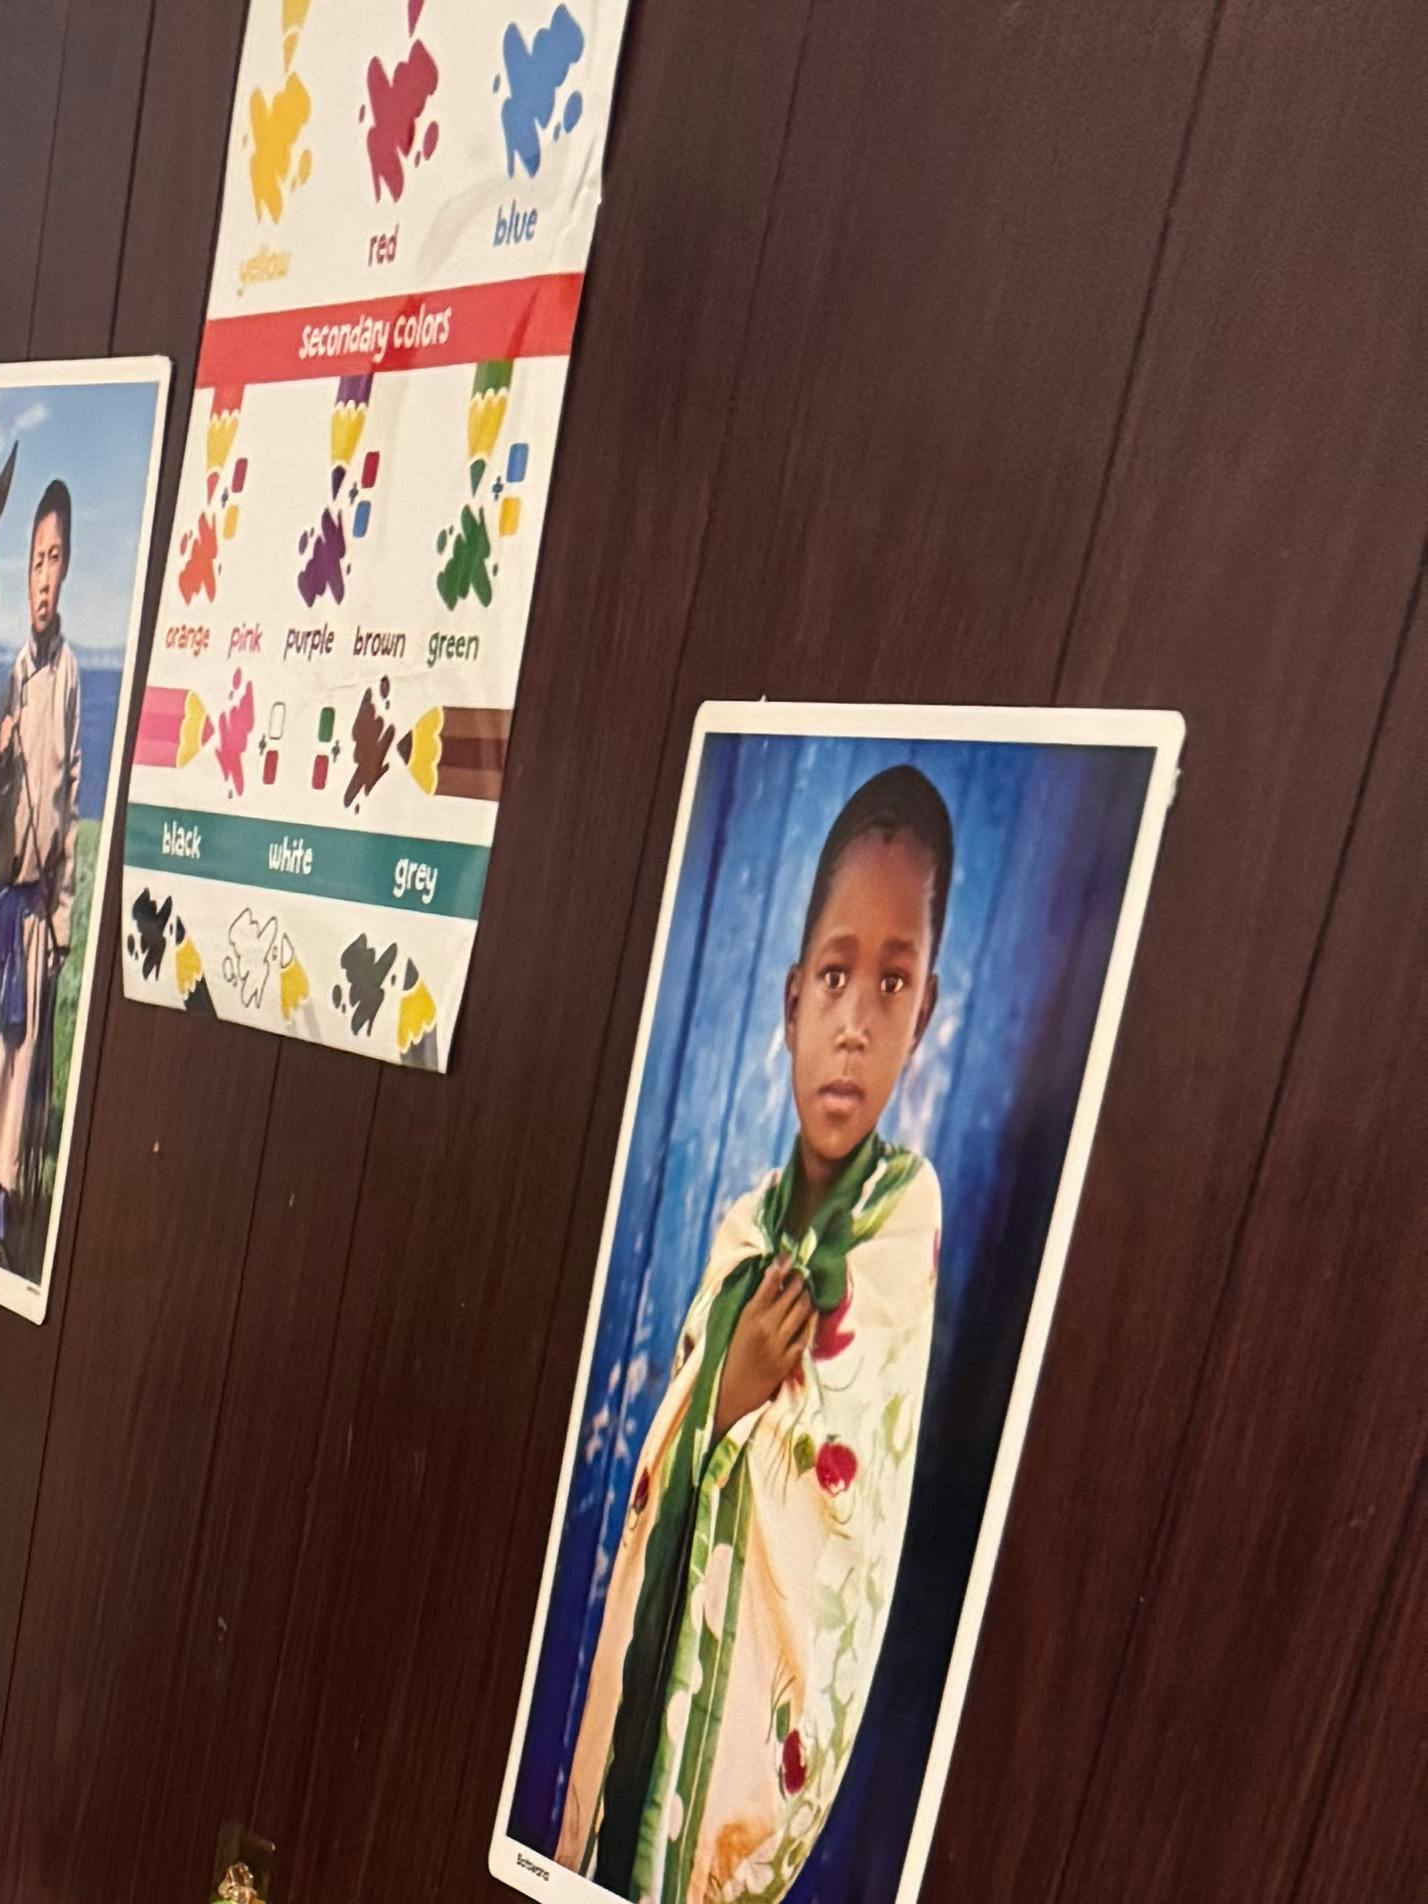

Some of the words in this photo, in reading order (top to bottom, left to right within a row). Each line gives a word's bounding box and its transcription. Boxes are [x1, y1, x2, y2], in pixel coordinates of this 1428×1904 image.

[492, 200, 538, 247] blue
[368, 221, 399, 266] red
[237, 246, 291, 296] yellow
[298, 314, 390, 361] secondary
[393, 303, 452, 344] colors
[165, 623, 211, 654] orange
[227, 622, 263, 658] pink
[283, 624, 335, 662] purple
[352, 627, 407, 658] brown
[427, 631, 480, 667] green
[162, 822, 201, 860] black
[268, 838, 313, 875] white
[394, 859, 438, 903] grey
